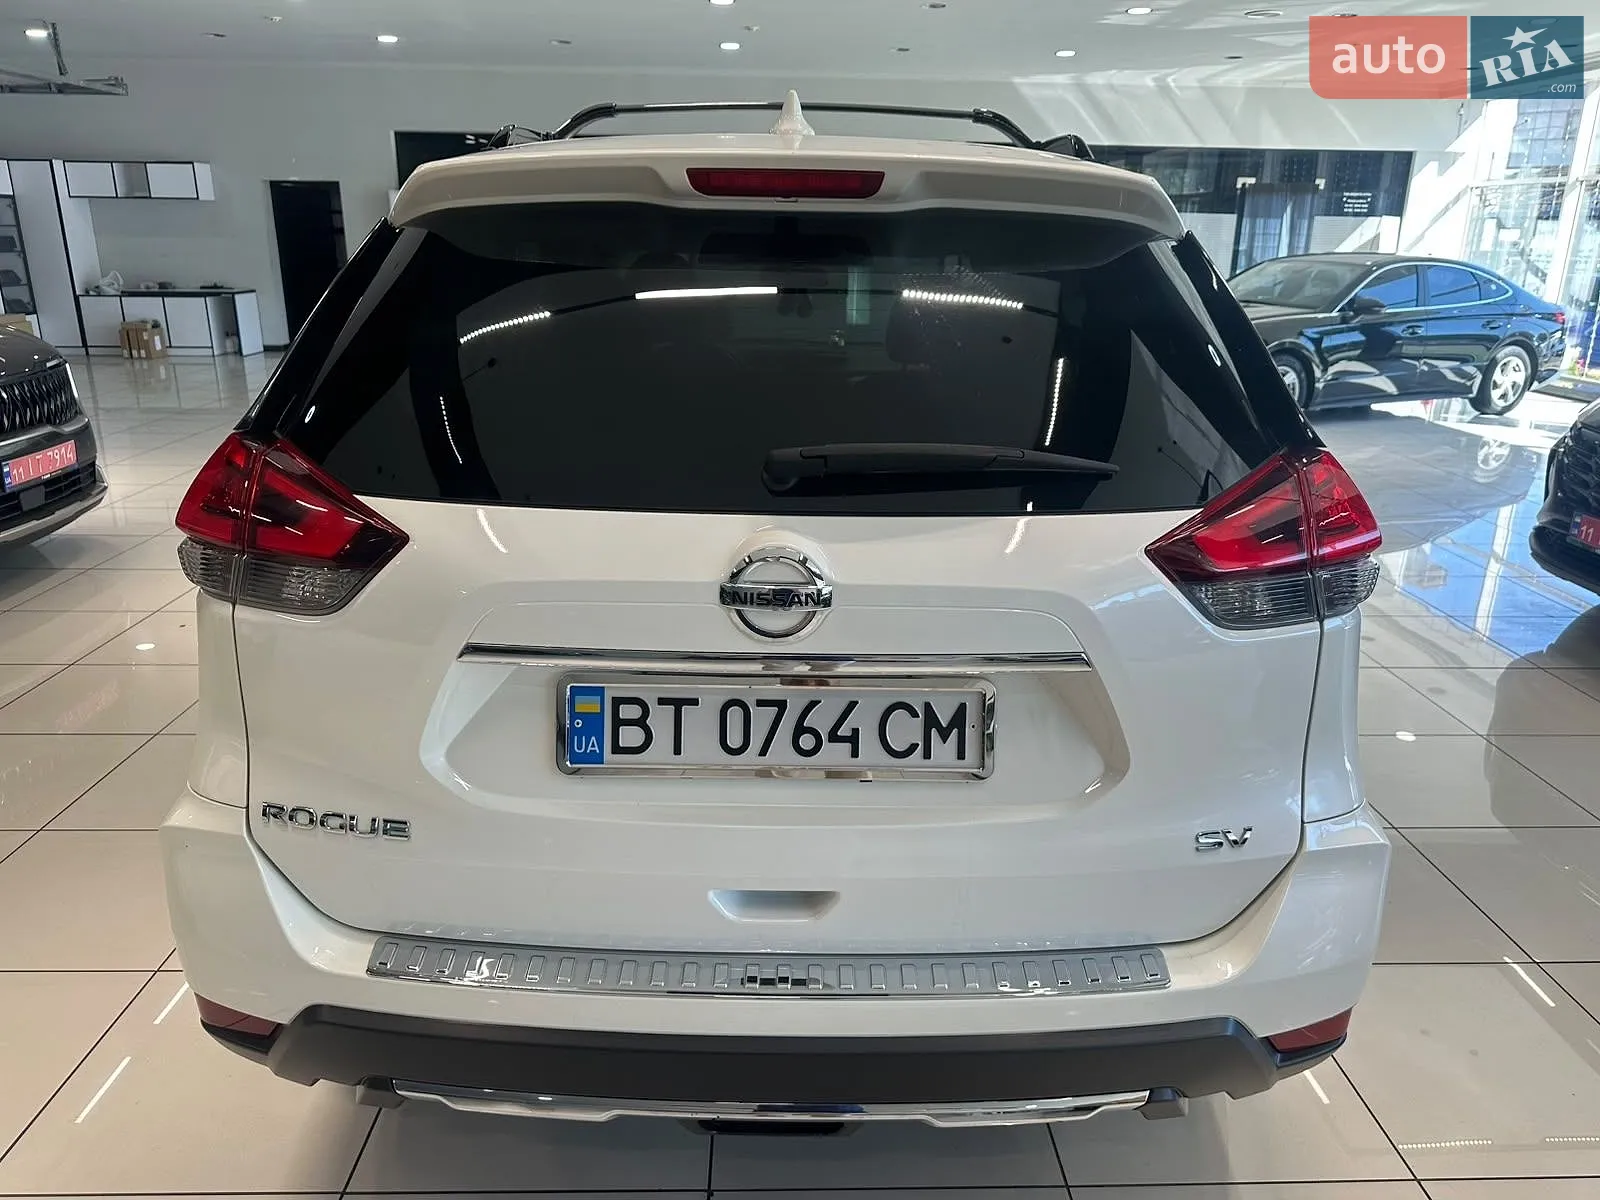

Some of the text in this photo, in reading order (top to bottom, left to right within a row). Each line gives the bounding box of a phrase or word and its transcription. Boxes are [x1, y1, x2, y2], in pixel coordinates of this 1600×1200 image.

[46, 444, 74, 470] 7914
[731, 588, 820, 607] NISSAN
[611, 696, 968, 761] BT 0764 CM
[574, 735, 600, 754] UA
[262, 801, 411, 841] ROGUE
[1195, 826, 1254, 852] SV
